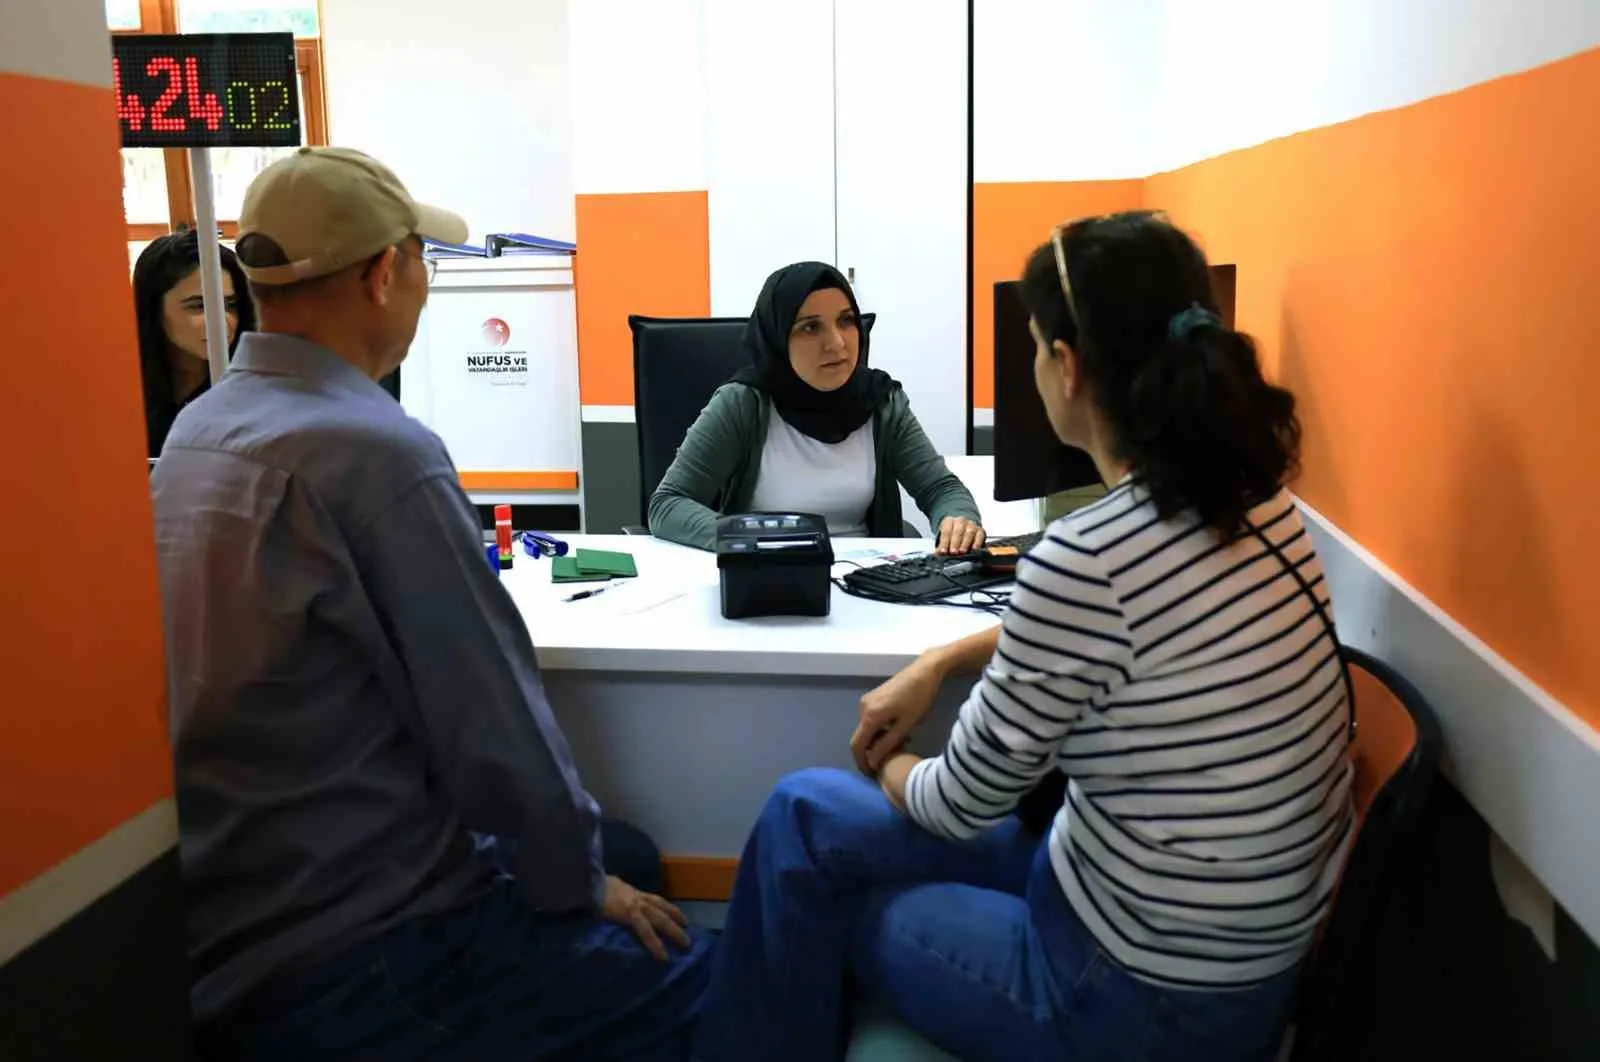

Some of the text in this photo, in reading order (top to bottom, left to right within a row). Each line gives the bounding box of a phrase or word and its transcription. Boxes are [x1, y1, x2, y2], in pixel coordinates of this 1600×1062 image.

[112, 56, 292, 131] 424 02
[513, 357, 528, 366] VE
